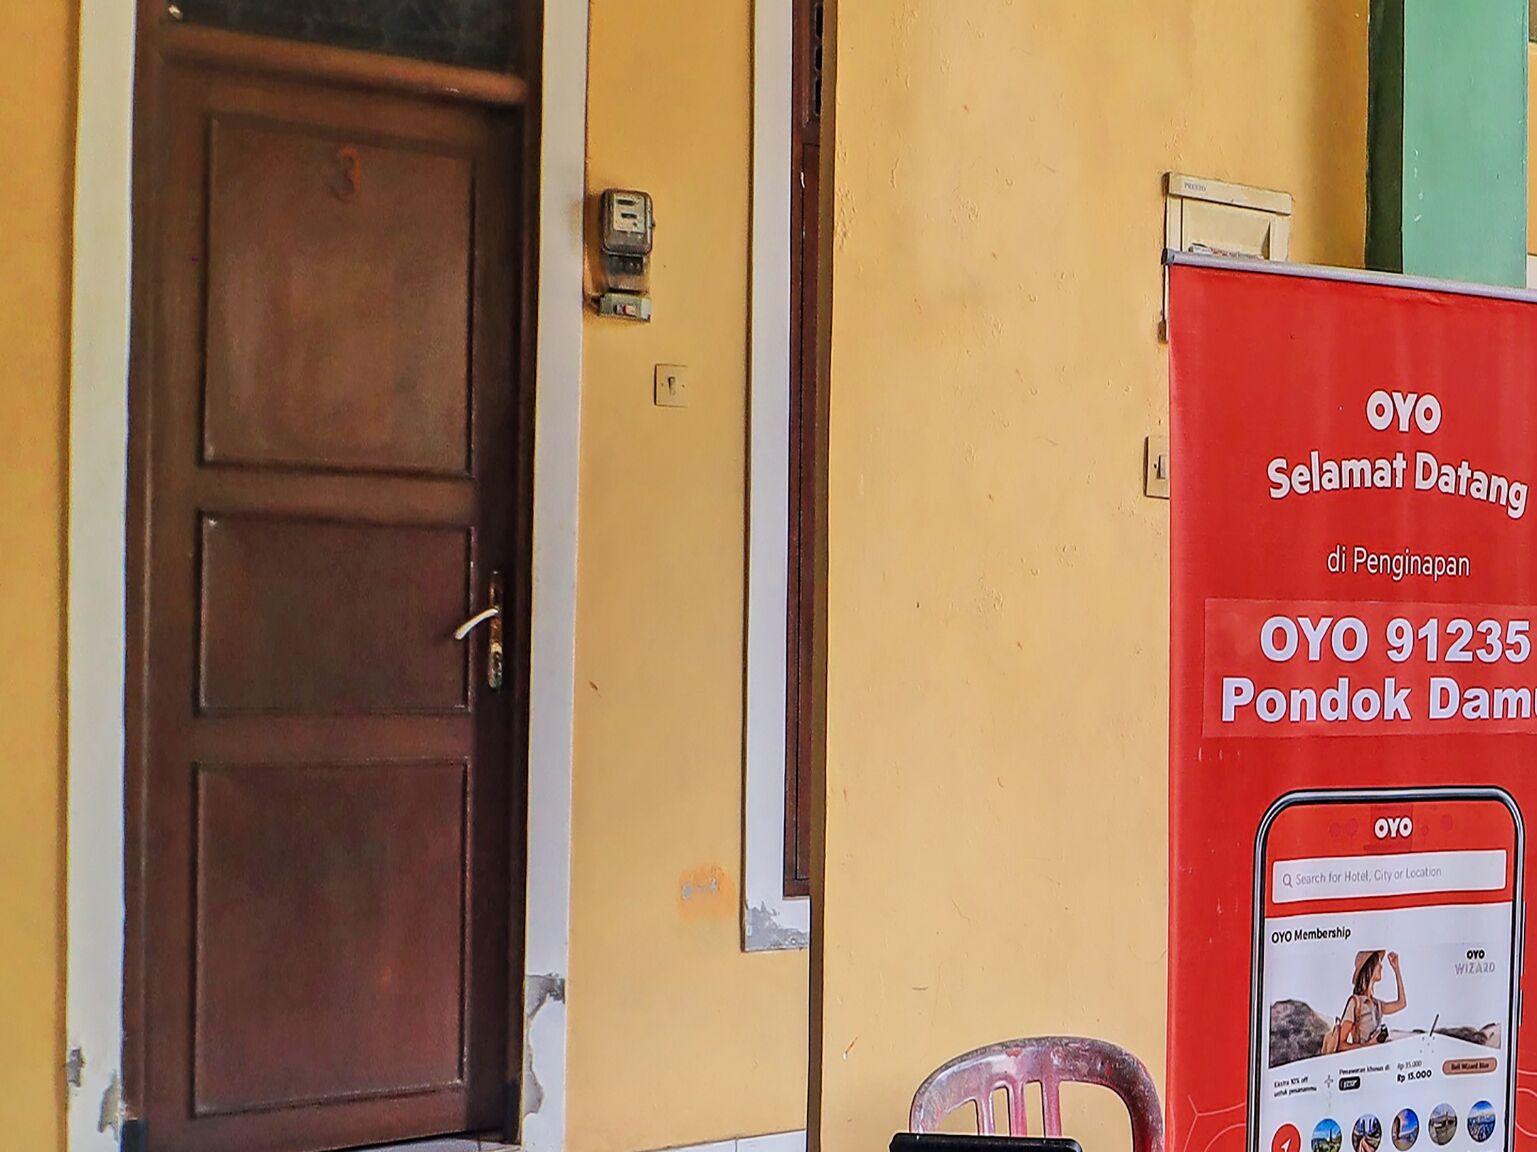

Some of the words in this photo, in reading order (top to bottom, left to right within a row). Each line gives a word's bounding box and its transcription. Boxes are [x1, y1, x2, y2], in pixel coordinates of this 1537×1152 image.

[1366, 390, 1442, 434] OYO
[1267, 451, 1406, 499] Selamat
[1414, 452, 1528, 519] Datang
[1327, 545, 1345, 574] di
[1353, 547, 1470, 580] Penginapan
[1260, 616, 1368, 662] OYO
[1386, 618, 1531, 663] 91235
[1221, 677, 1411, 721] Pondok
[1374, 816, 1412, 839] OYO
[1296, 870, 1326, 885] Search
[1328, 870, 1341, 883] for
[1344, 870, 1371, 884] Hotel,
[1374, 868, 1392, 882] City
[1394, 870, 1403, 880] or
[1406, 866, 1442, 879] Location
[1271, 930, 1292, 944] OYO
[1294, 927, 1351, 943] Membership
[1466, 949, 1485, 960] OYO
